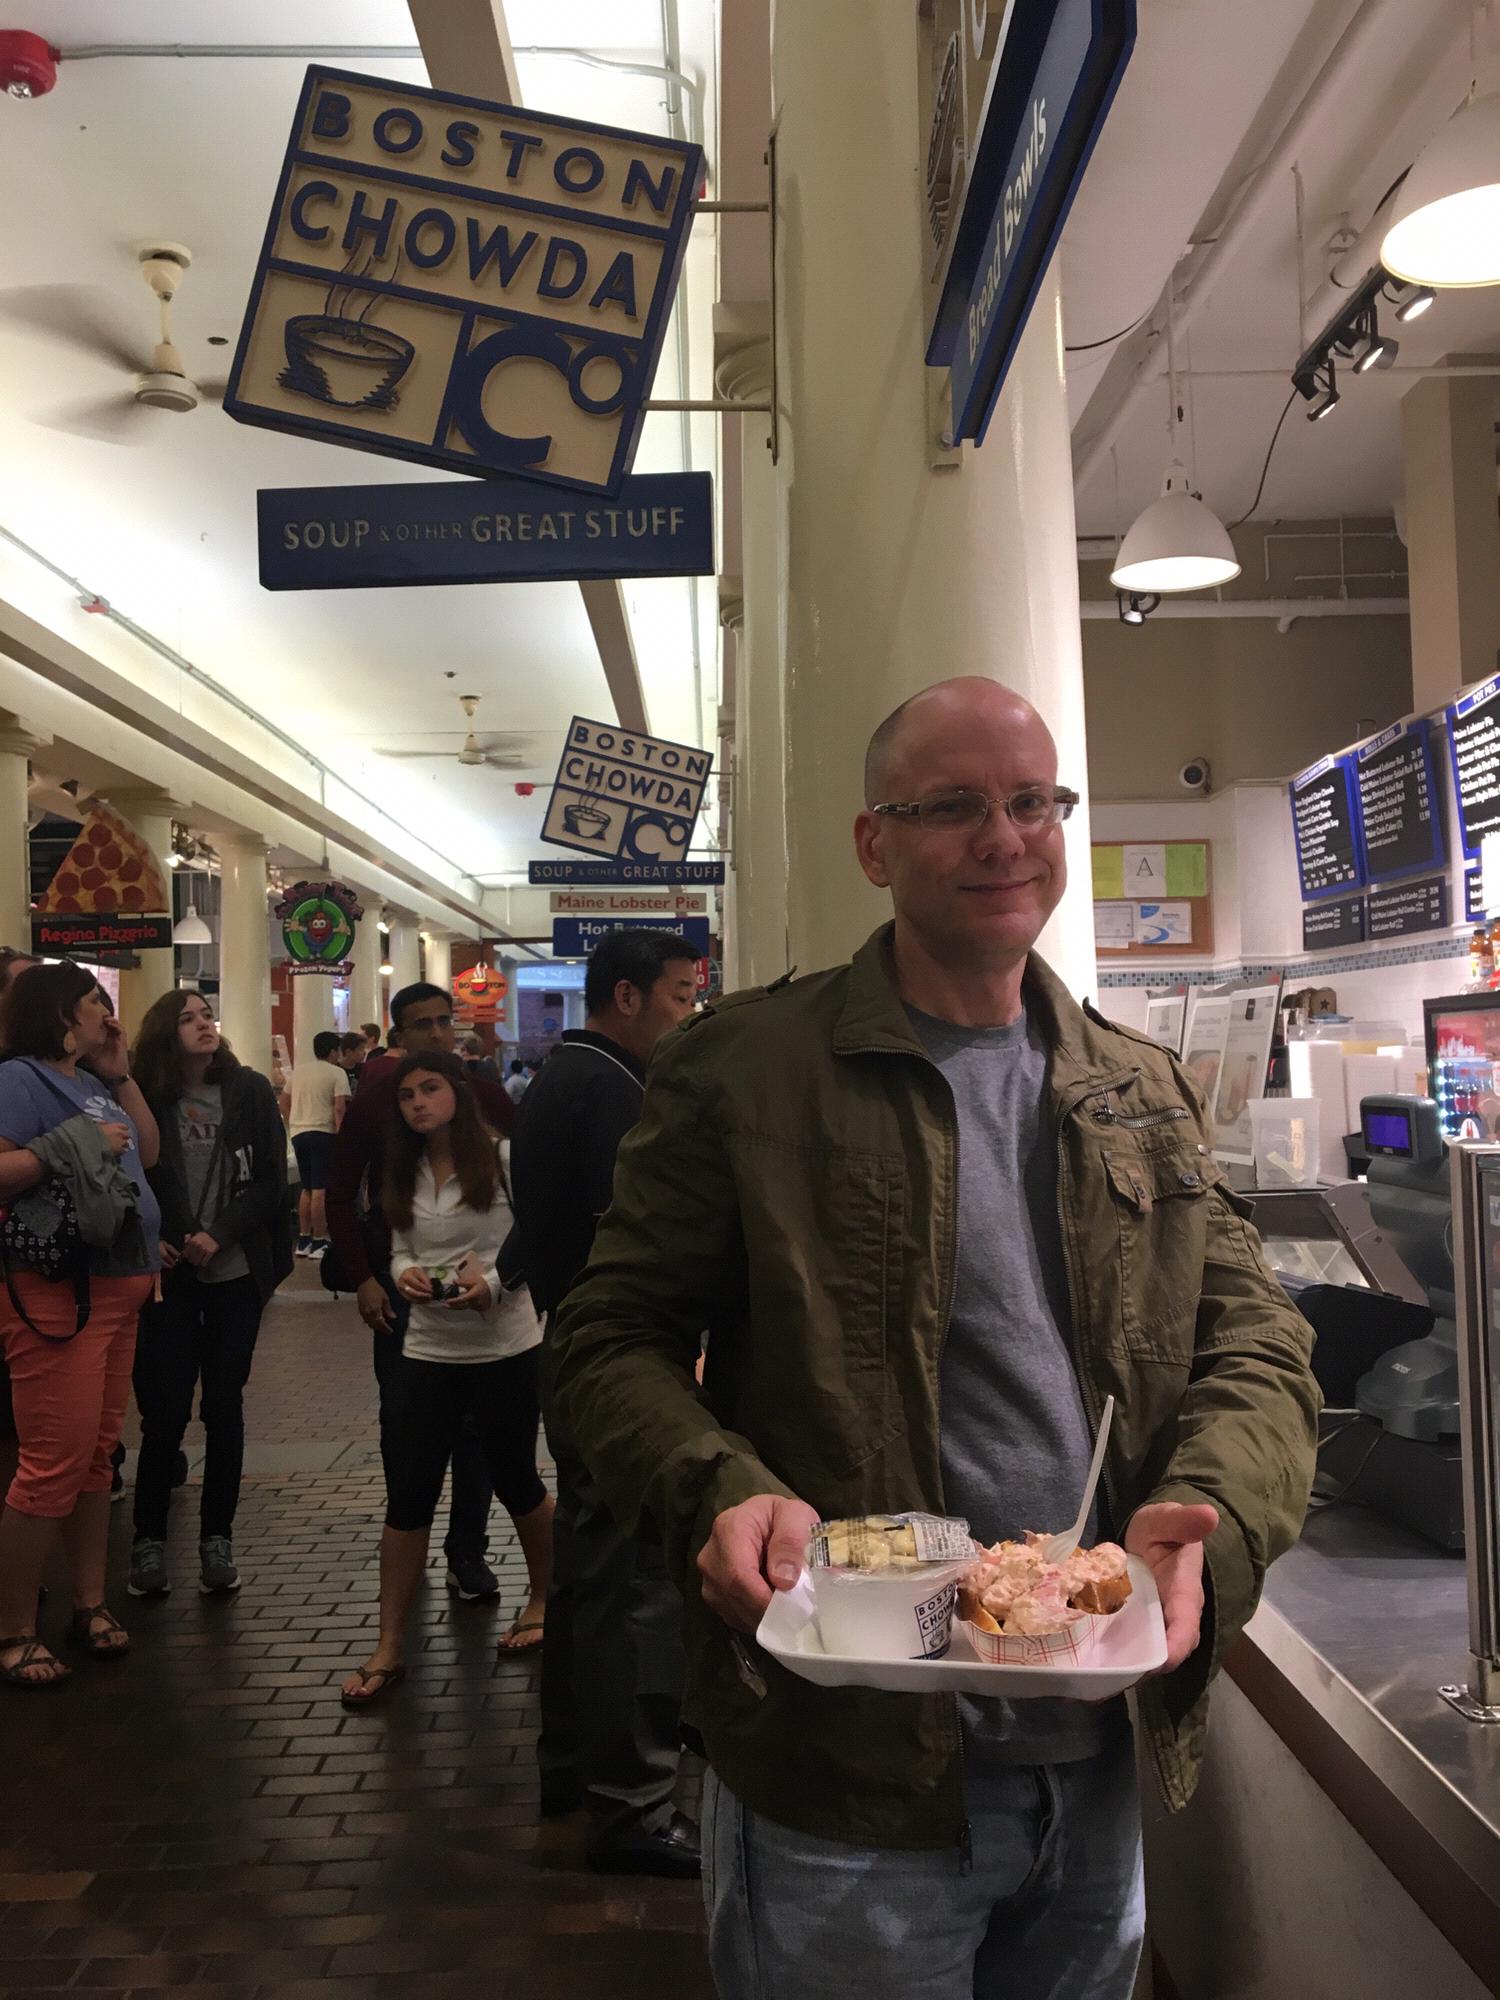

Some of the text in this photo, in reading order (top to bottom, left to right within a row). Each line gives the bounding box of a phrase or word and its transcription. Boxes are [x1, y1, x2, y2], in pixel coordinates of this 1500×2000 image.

[311, 91, 676, 212] BOSTON
[290, 179, 639, 317] CHOWDA
[969, 96, 1047, 367] Bread Bowls
[284, 519, 369, 550] SOUP
[396, 520, 463, 542] OTHER
[471, 512, 572, 543] GREAT
[585, 506, 686, 539] STUFF
[573, 725, 706, 776] BOSTON
[566, 757, 691, 811] CHOWDA
[533, 865, 573, 878] SOUP
[623, 865, 668, 878] GREAT
[675, 865, 720, 878] STUFF
[1136, 857, 1154, 876] A
[557, 893, 699, 909] Maine Lobster Pie
[41, 925, 158, 944] Regina Pizzeria
[578, 922, 608, 935] Hot
